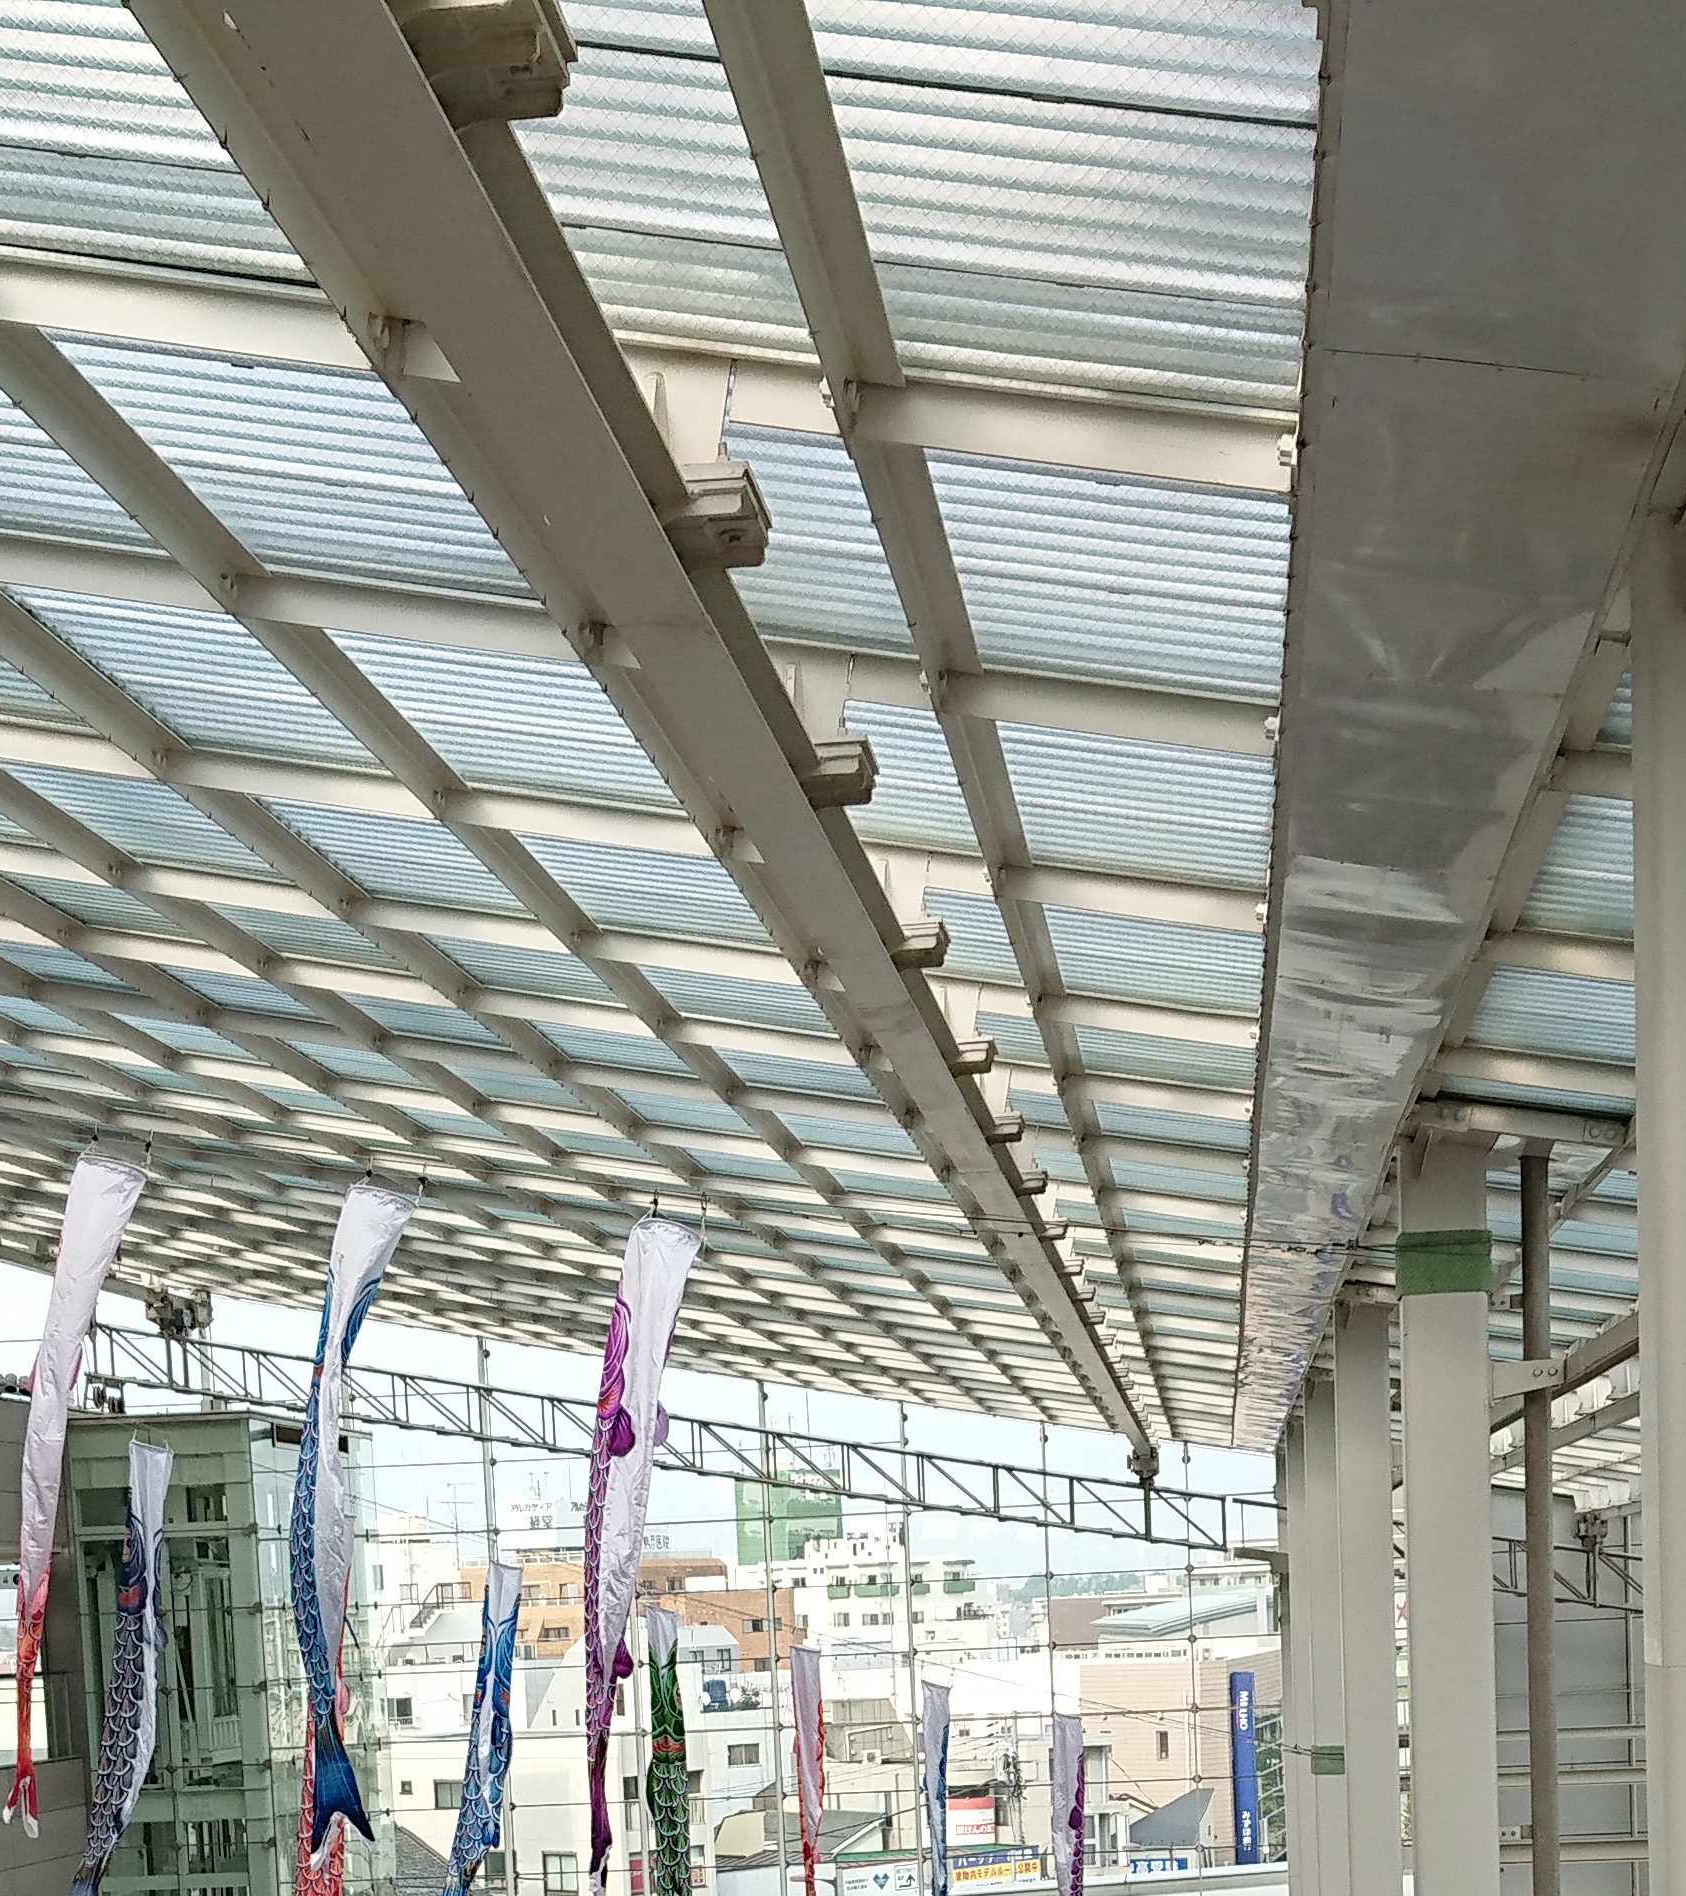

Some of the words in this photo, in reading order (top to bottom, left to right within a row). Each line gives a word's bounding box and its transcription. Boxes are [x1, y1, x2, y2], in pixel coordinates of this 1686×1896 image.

[955, 1861, 1038, 1881] 建物内モデルルー公開中
